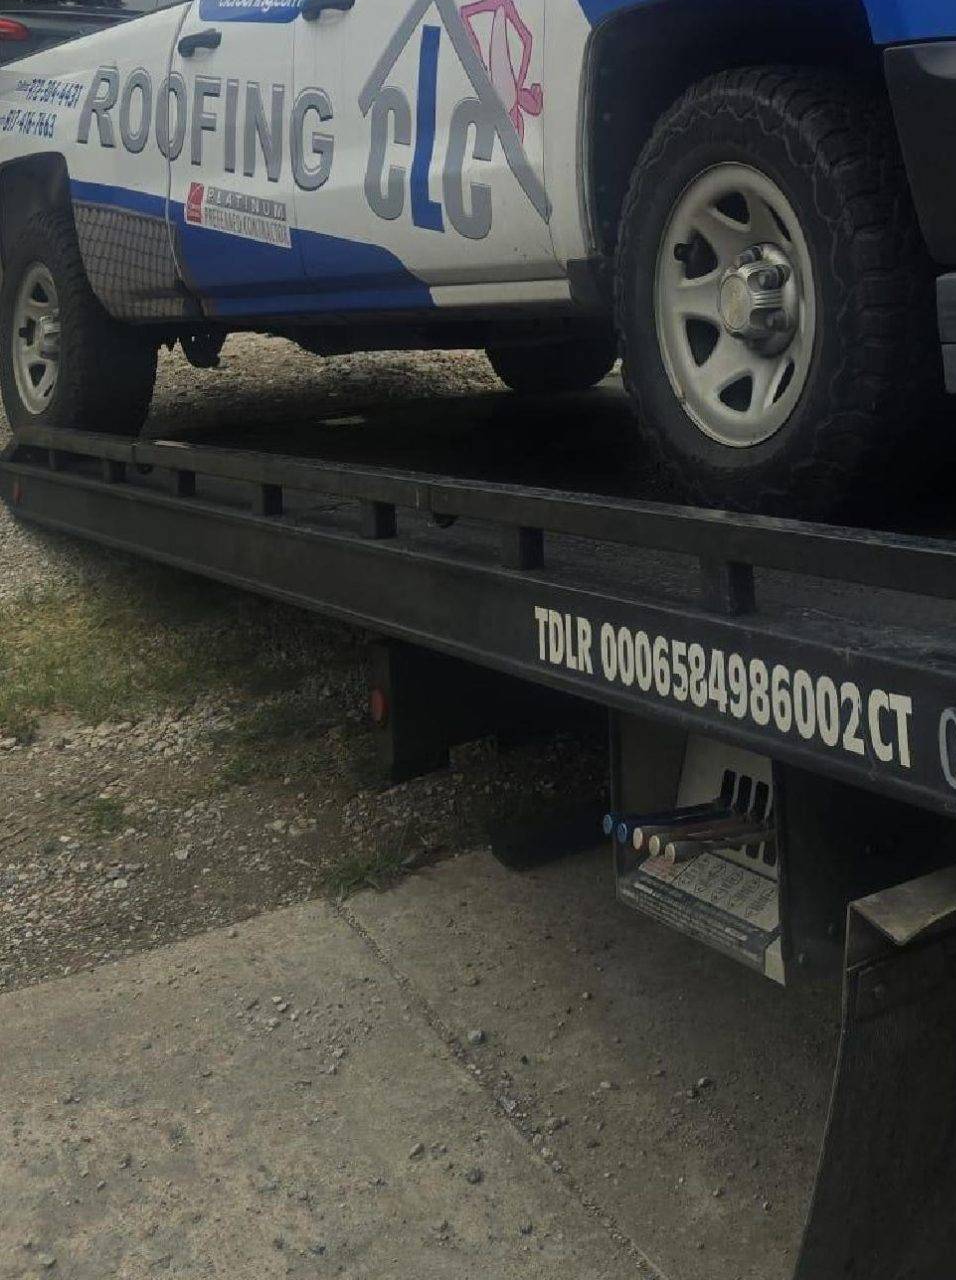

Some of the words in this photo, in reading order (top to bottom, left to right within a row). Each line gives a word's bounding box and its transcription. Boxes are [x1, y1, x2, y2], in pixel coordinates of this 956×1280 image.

[77, 65, 335, 191] ROOFING
[364, 23, 493, 240] CLC
[207, 187, 286, 221] PLATINUM
[534, 605, 594, 675] TDLR
